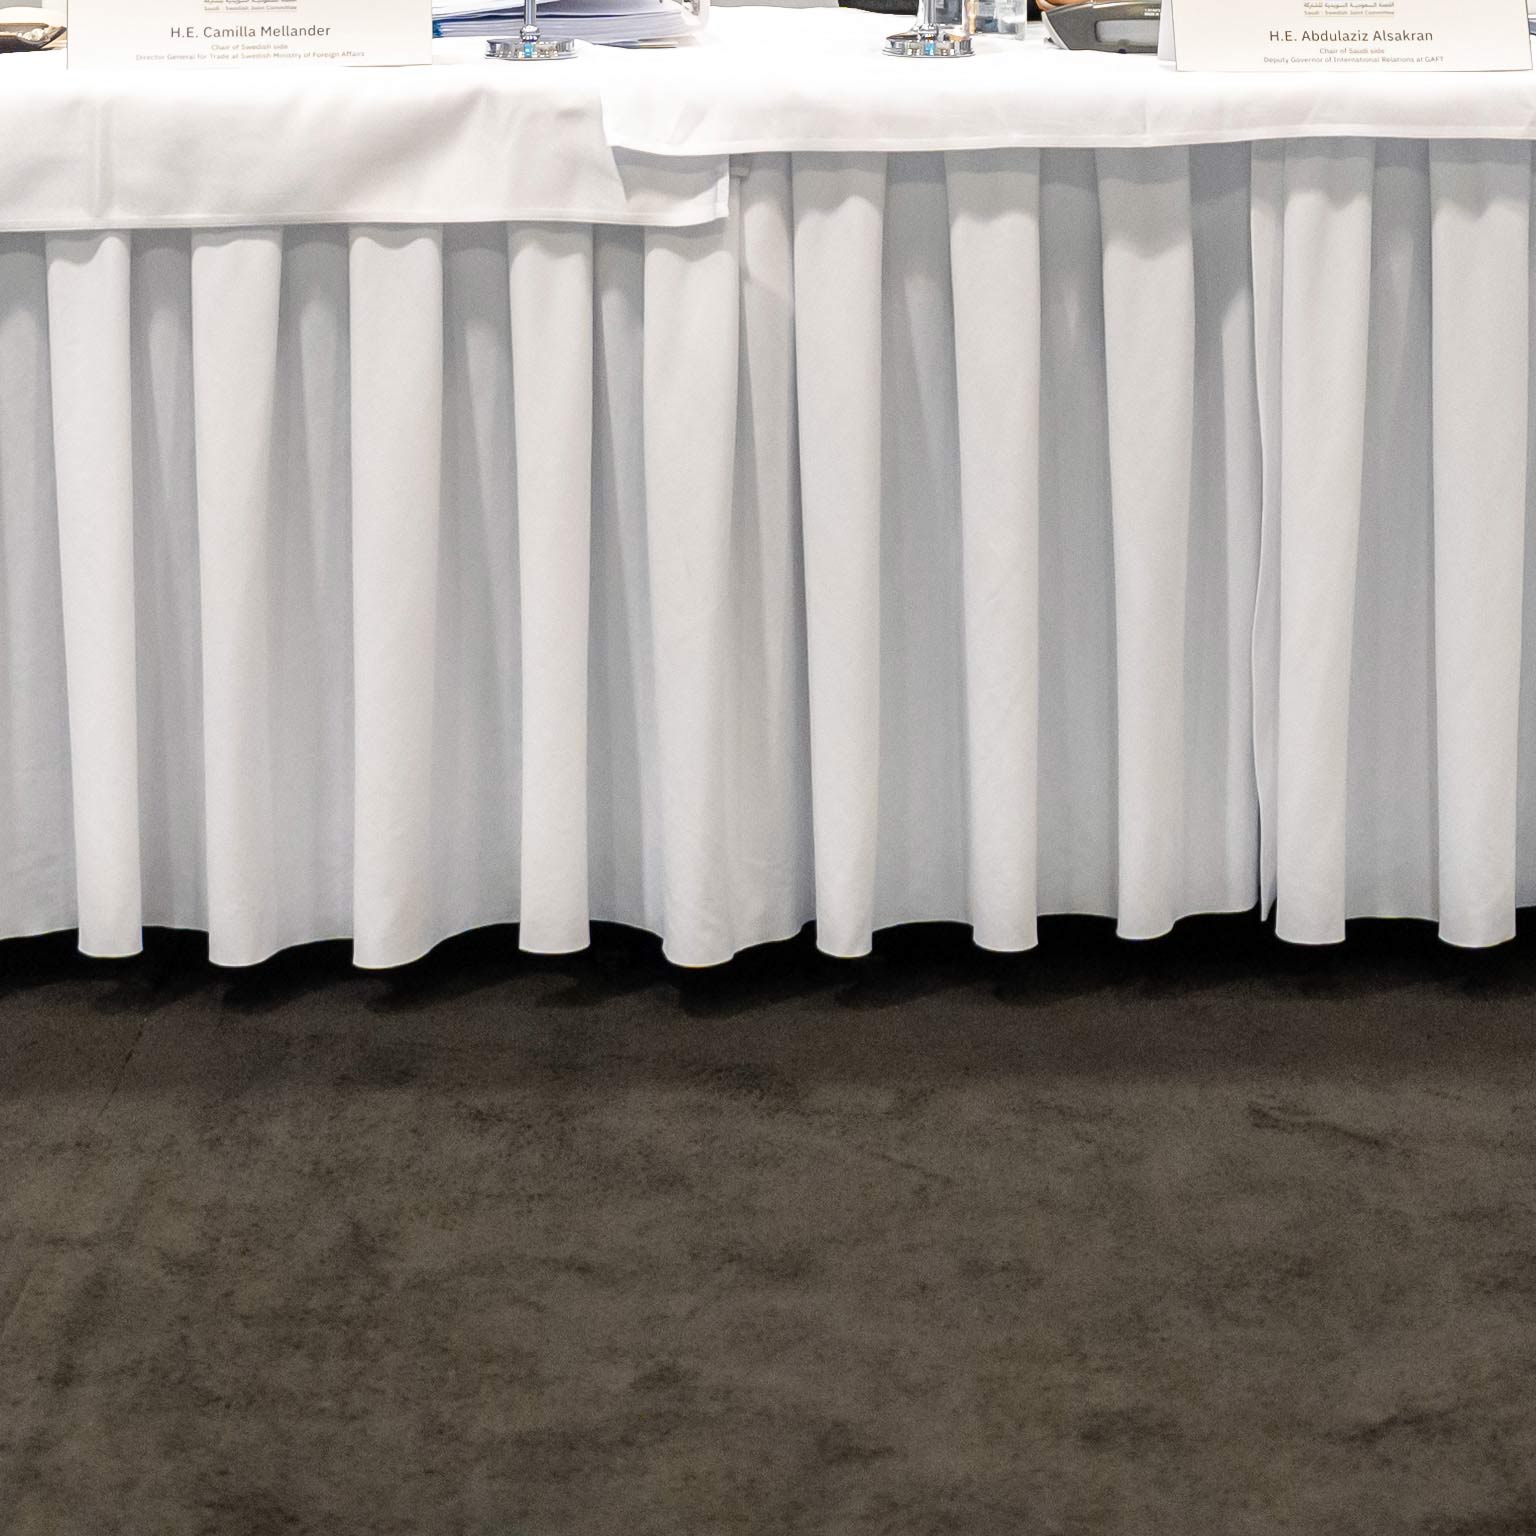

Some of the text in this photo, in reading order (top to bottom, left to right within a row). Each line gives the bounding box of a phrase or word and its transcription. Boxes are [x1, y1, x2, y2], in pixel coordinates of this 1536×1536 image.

[170, 24, 331, 39] H.E. Camilla Mellander
[1269, 29, 1433, 42] H.E. Abdulaziz Alsakran
